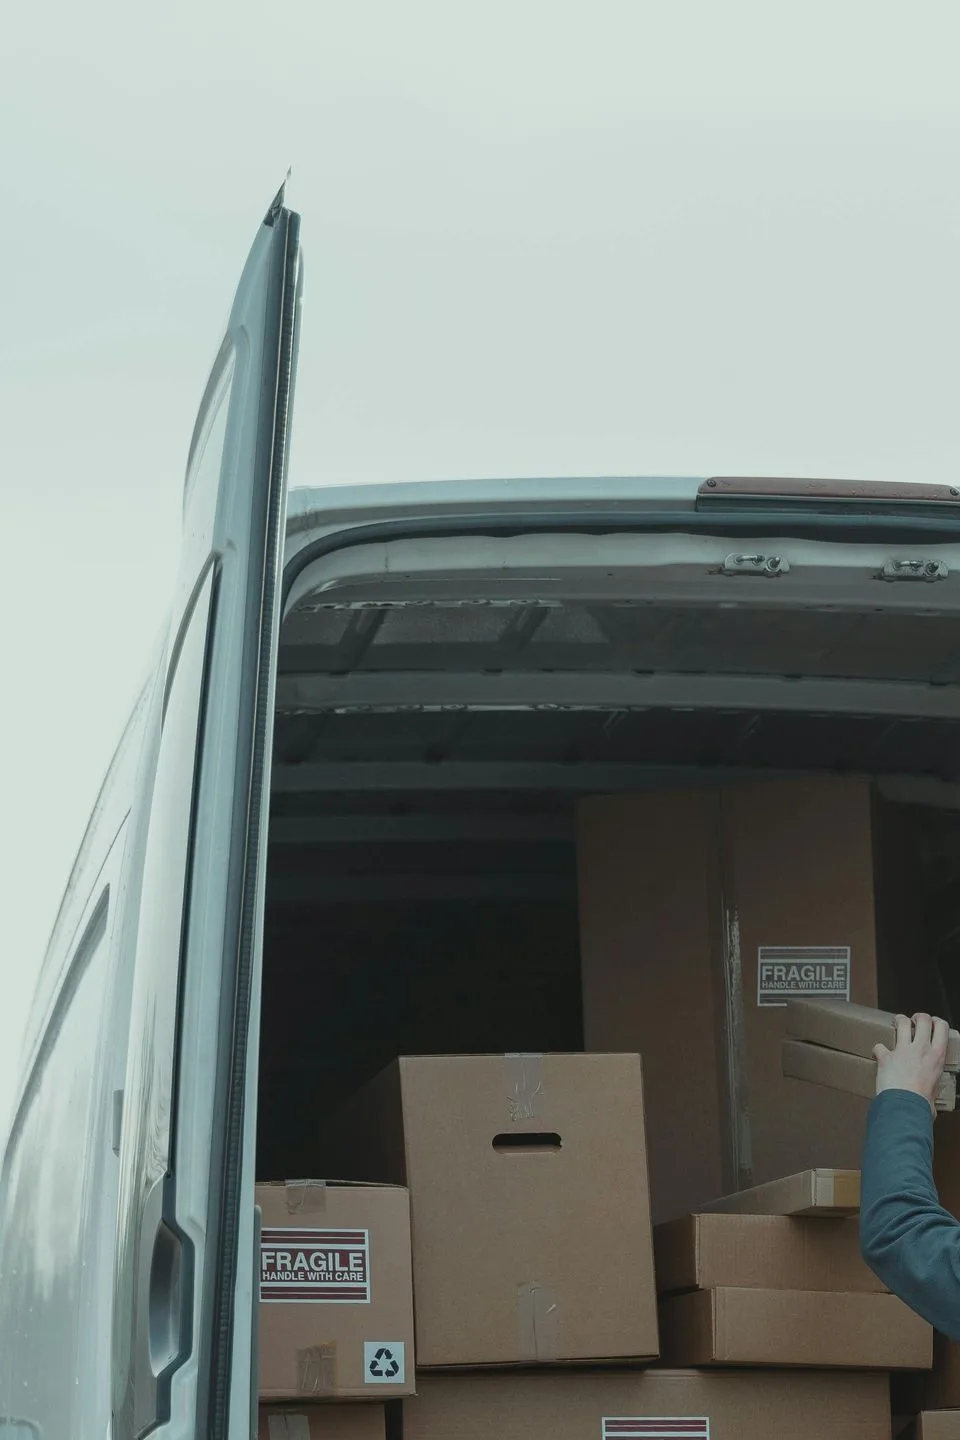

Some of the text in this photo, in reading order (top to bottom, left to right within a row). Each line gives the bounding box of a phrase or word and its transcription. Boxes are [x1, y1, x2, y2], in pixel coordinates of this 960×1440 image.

[762, 965, 845, 981] FRAGILE
[762, 981, 845, 989] HANDLE WITH CARE
[261, 1251, 364, 1271] FRAGILE
[262, 1271, 364, 1281] HANDLE WITH CARE
